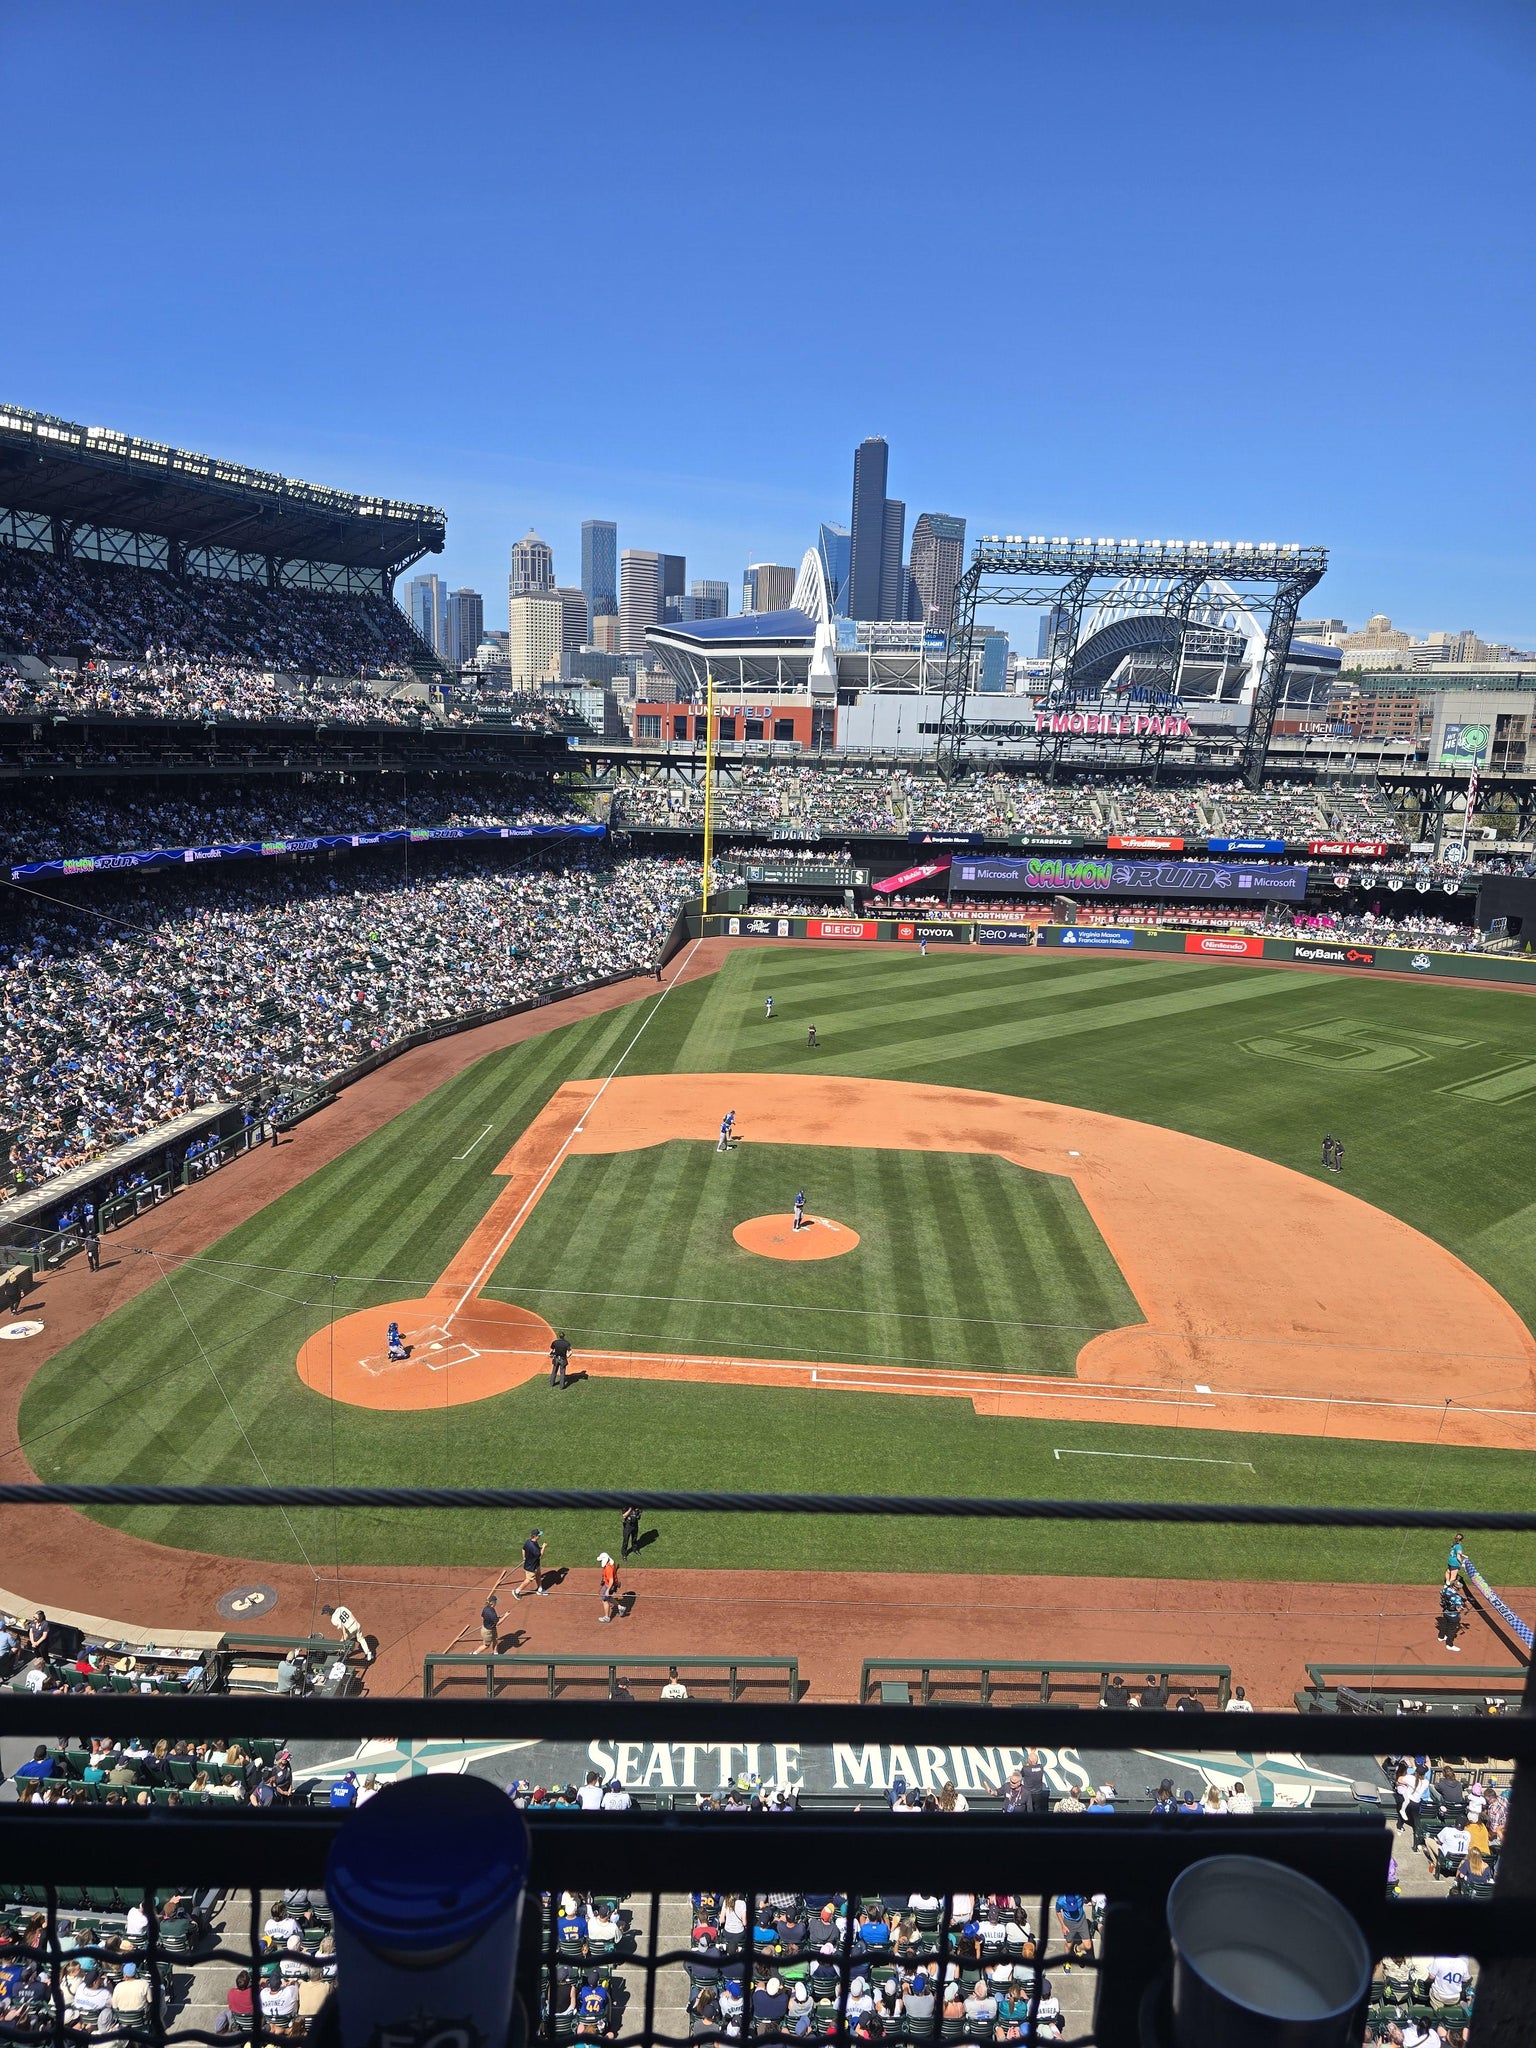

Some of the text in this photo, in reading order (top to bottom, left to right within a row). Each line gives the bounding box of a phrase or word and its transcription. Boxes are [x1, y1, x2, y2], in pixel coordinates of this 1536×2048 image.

[1050, 686, 1183, 710] SEATTLE MARINERS
[734, 706, 772, 717] FIELD
[1034, 713, 1194, 736] T-MOBILE PARK
[1299, 722, 1332, 733] LUMEN
[194, 851, 222, 860] Microsoft
[99, 857, 133, 868] RUN
[978, 869, 1018, 879] Microsoft
[1026, 858, 1219, 889] SALMON RUN
[1254, 878, 1296, 887] Microsoft
[1364, 879, 1373, 887] 24
[1447, 884, 1455, 892] 51
[971, 912, 1025, 920] NORTHWEST
[1109, 916, 1145, 924] BGGEST
[917, 928, 953, 937] TOYOTA
[1205, 942, 1243, 950] Nintendo
[1295, 947, 1344, 961] KeyBank
[1415, 955, 1428, 964] 50
[339, 1610, 350, 1623] 88
[585, 1739, 1090, 1792] SEATTLE MARINERS
[1457, 1840, 1465, 1852] 11
[1443, 1971, 1462, 1984] 40
[585, 2001, 600, 2013] 44
